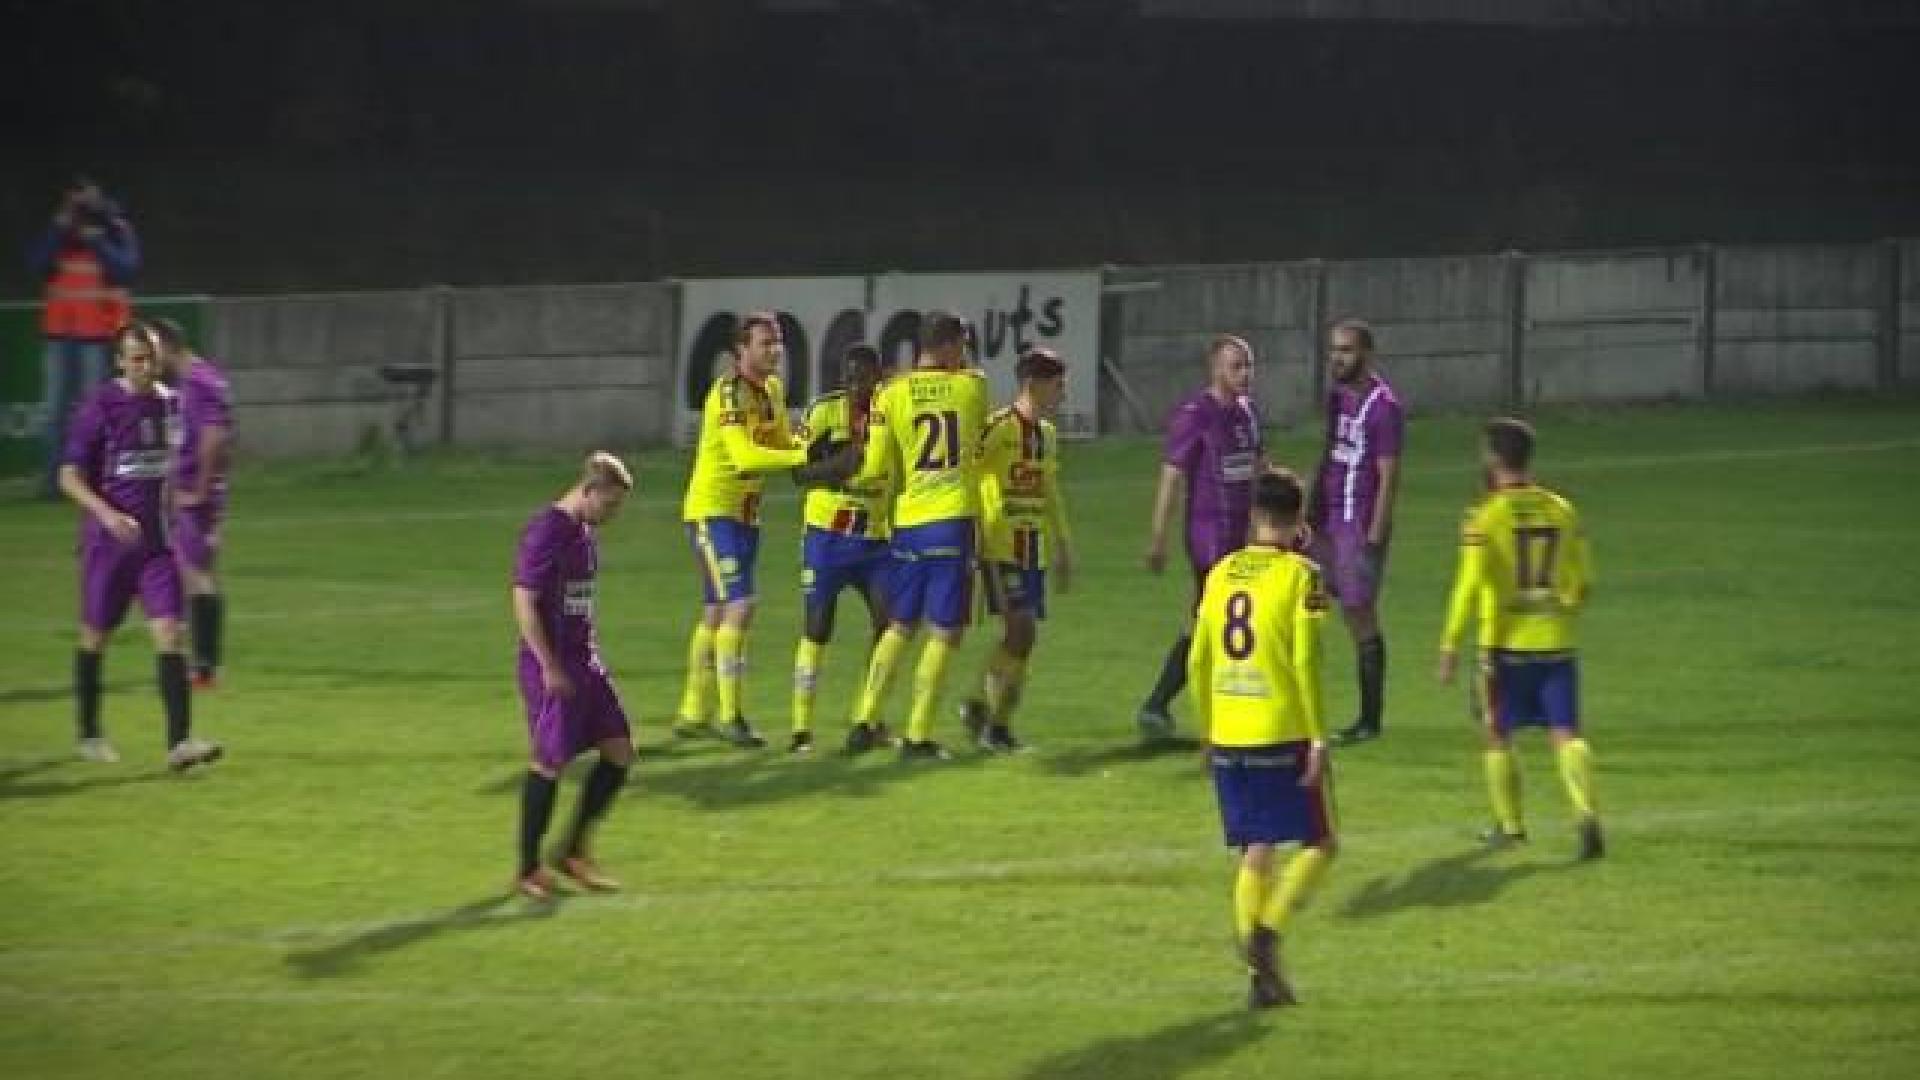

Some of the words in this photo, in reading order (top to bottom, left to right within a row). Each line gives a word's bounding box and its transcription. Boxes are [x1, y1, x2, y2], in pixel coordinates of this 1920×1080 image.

[914, 409, 959, 471] 21
[1512, 527, 1561, 589] 17
[1223, 591, 1255, 661] 8
